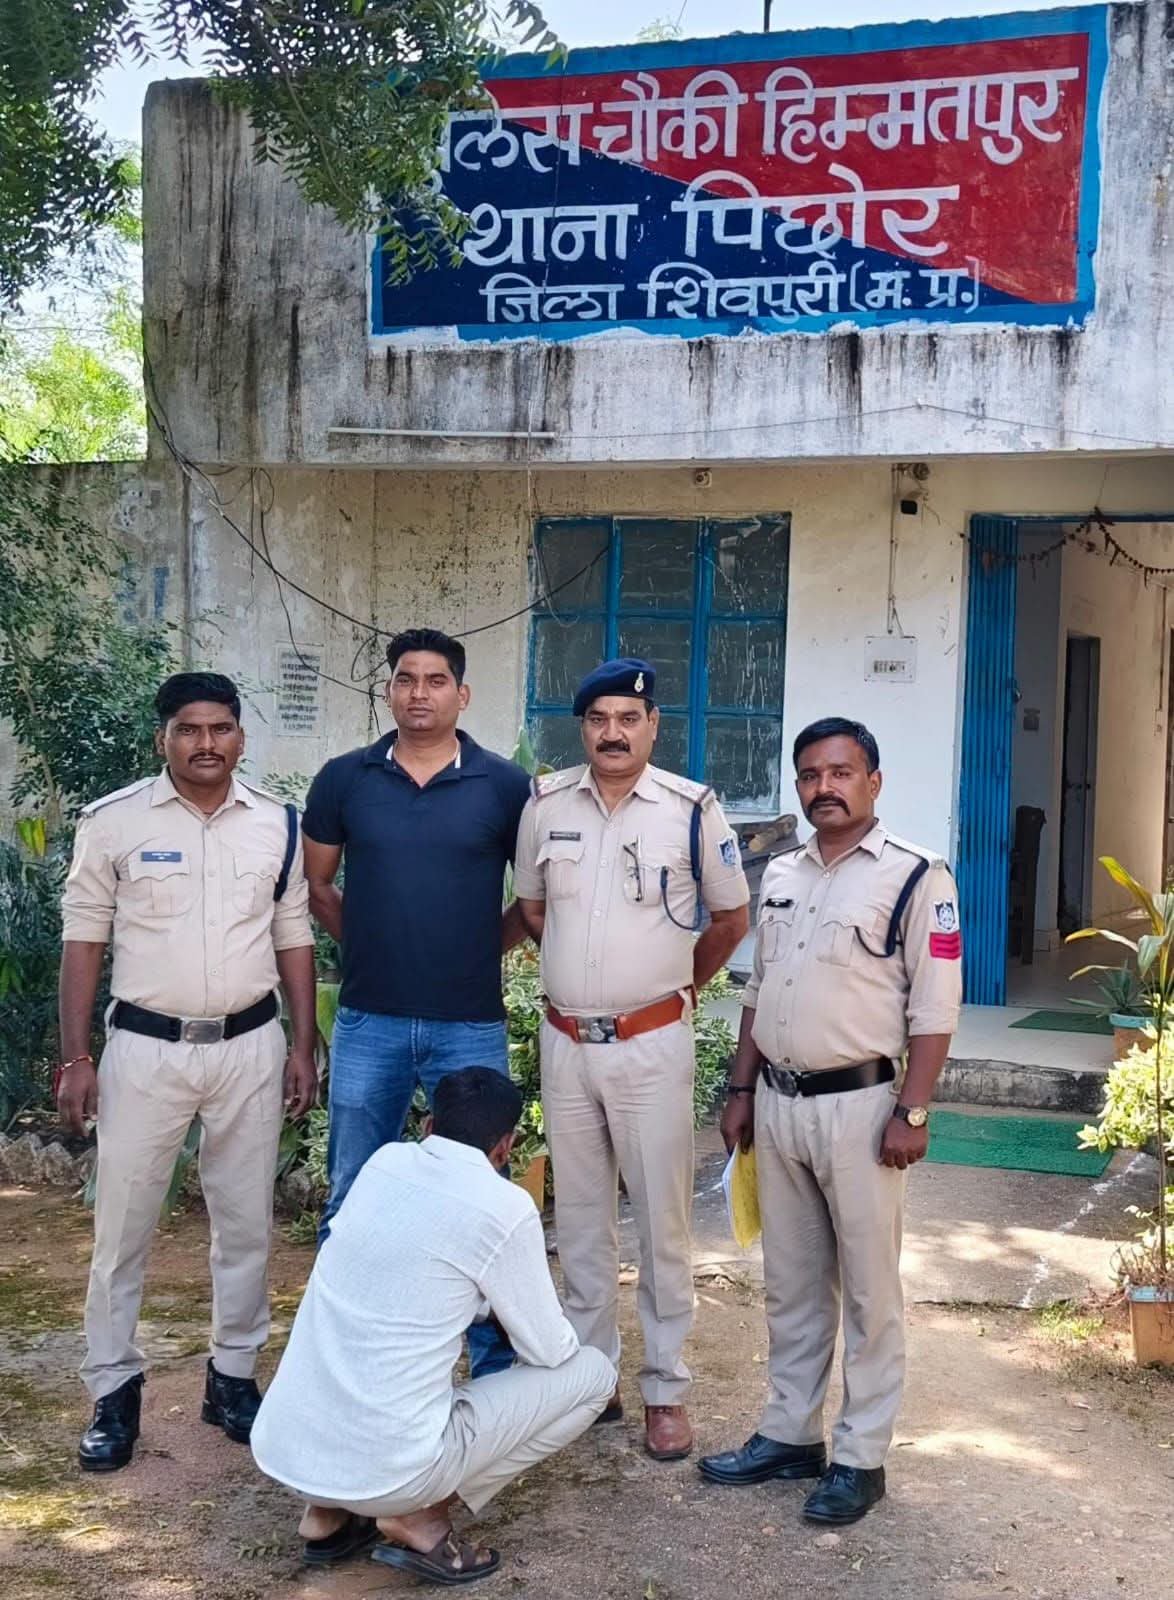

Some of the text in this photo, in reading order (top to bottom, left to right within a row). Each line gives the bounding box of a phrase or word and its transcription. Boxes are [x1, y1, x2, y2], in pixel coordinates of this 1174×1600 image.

[593, 70, 748, 163] चौकी
[754, 66, 1080, 165] हिम्मतपुर
[463, 162, 960, 267] थाना पिछोर
[479, 272, 625, 323] जिला
[637, 260, 847, 324] शिवपुरी
